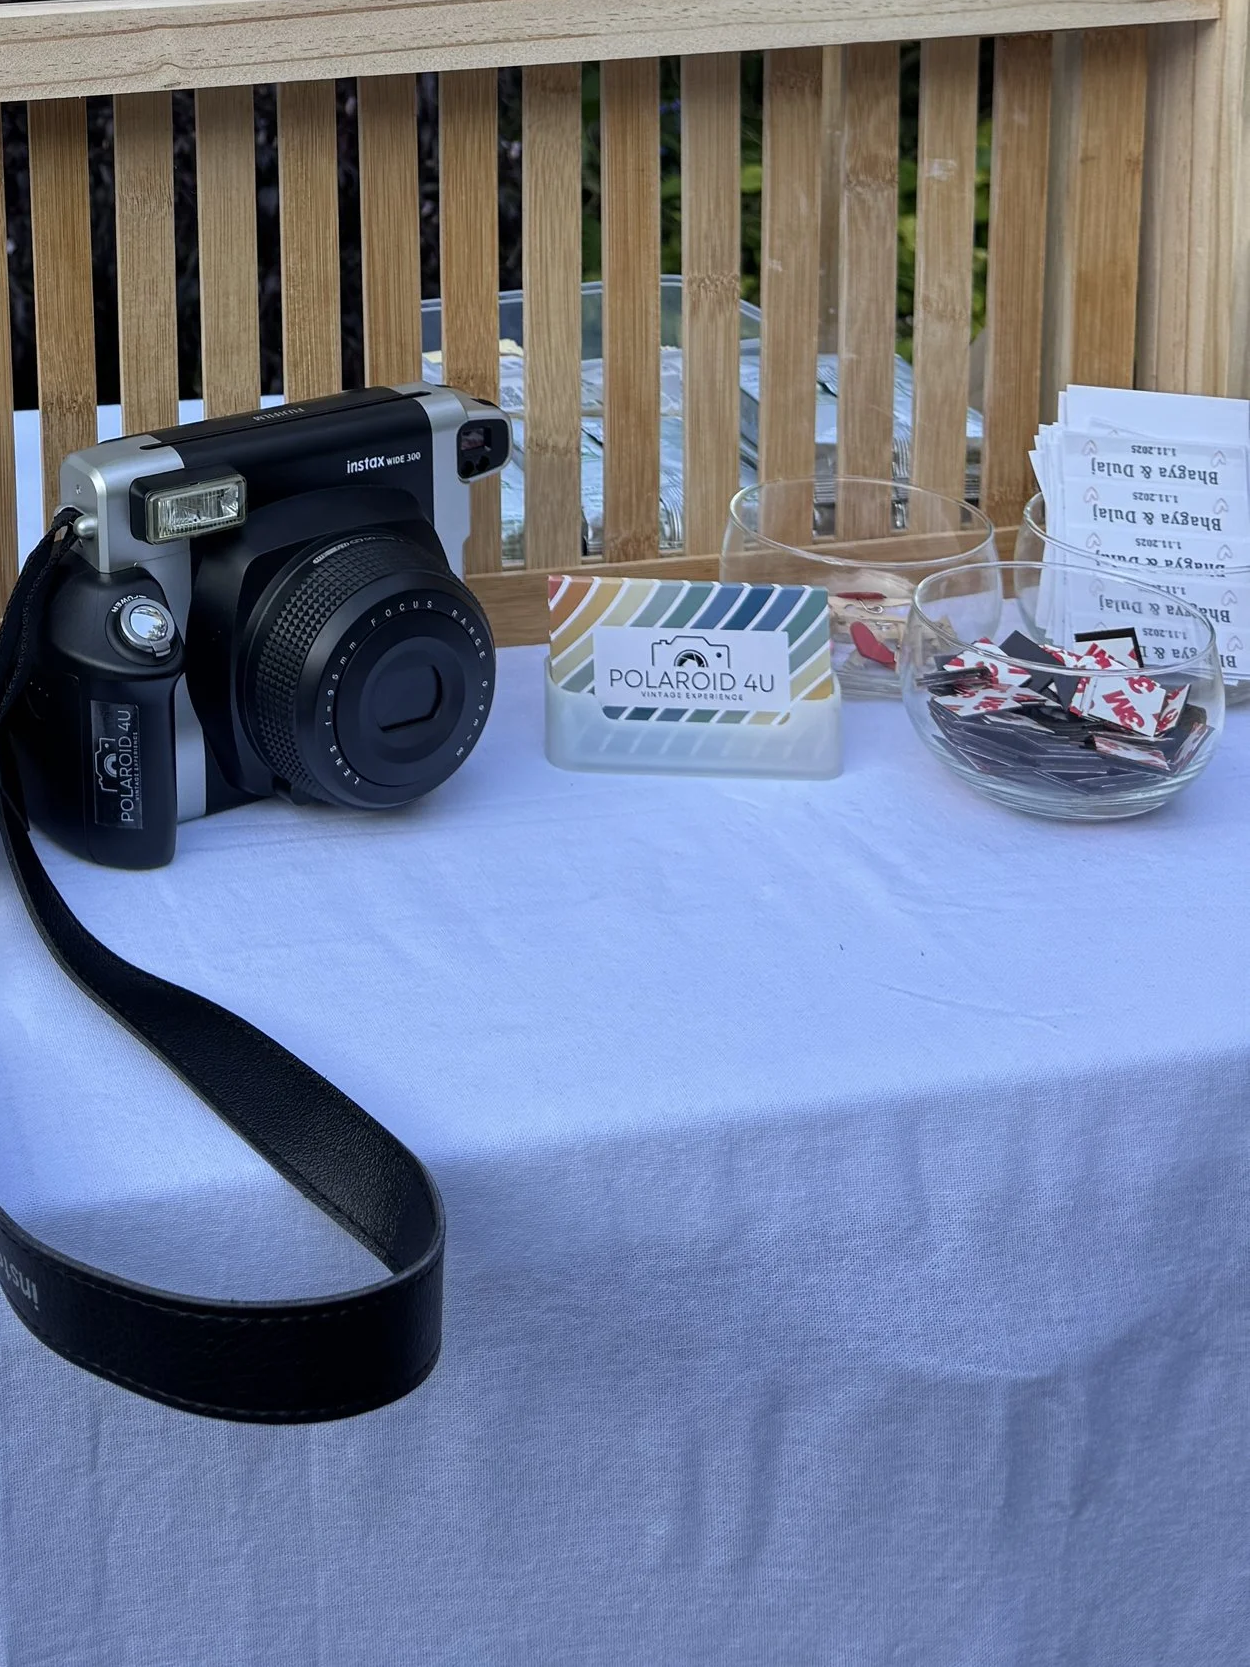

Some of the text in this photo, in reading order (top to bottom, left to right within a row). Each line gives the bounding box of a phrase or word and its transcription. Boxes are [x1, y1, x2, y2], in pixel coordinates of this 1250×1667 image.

[1130, 444, 1176, 456] 1.11.2025
[346, 452, 421, 474] instax WIDE 300
[1091, 457, 1218, 485] Bhagya & Dulaj
[1132, 492, 1178, 504] 1.11.2025
[1093, 504, 1222, 532] Bhagya & Dulaj
[1135, 538, 1182, 550] 1.11.2025
[1099, 594, 1143, 614] Dulaj
[371, 600, 486, 659] FOCUS RANGE
[610, 668, 774, 693] POLAROID 4U
[686, 692, 744, 701] EXPERIENCE
[1102, 690, 1144, 730] 3M
[118, 710, 134, 821] POLAROID 4U
